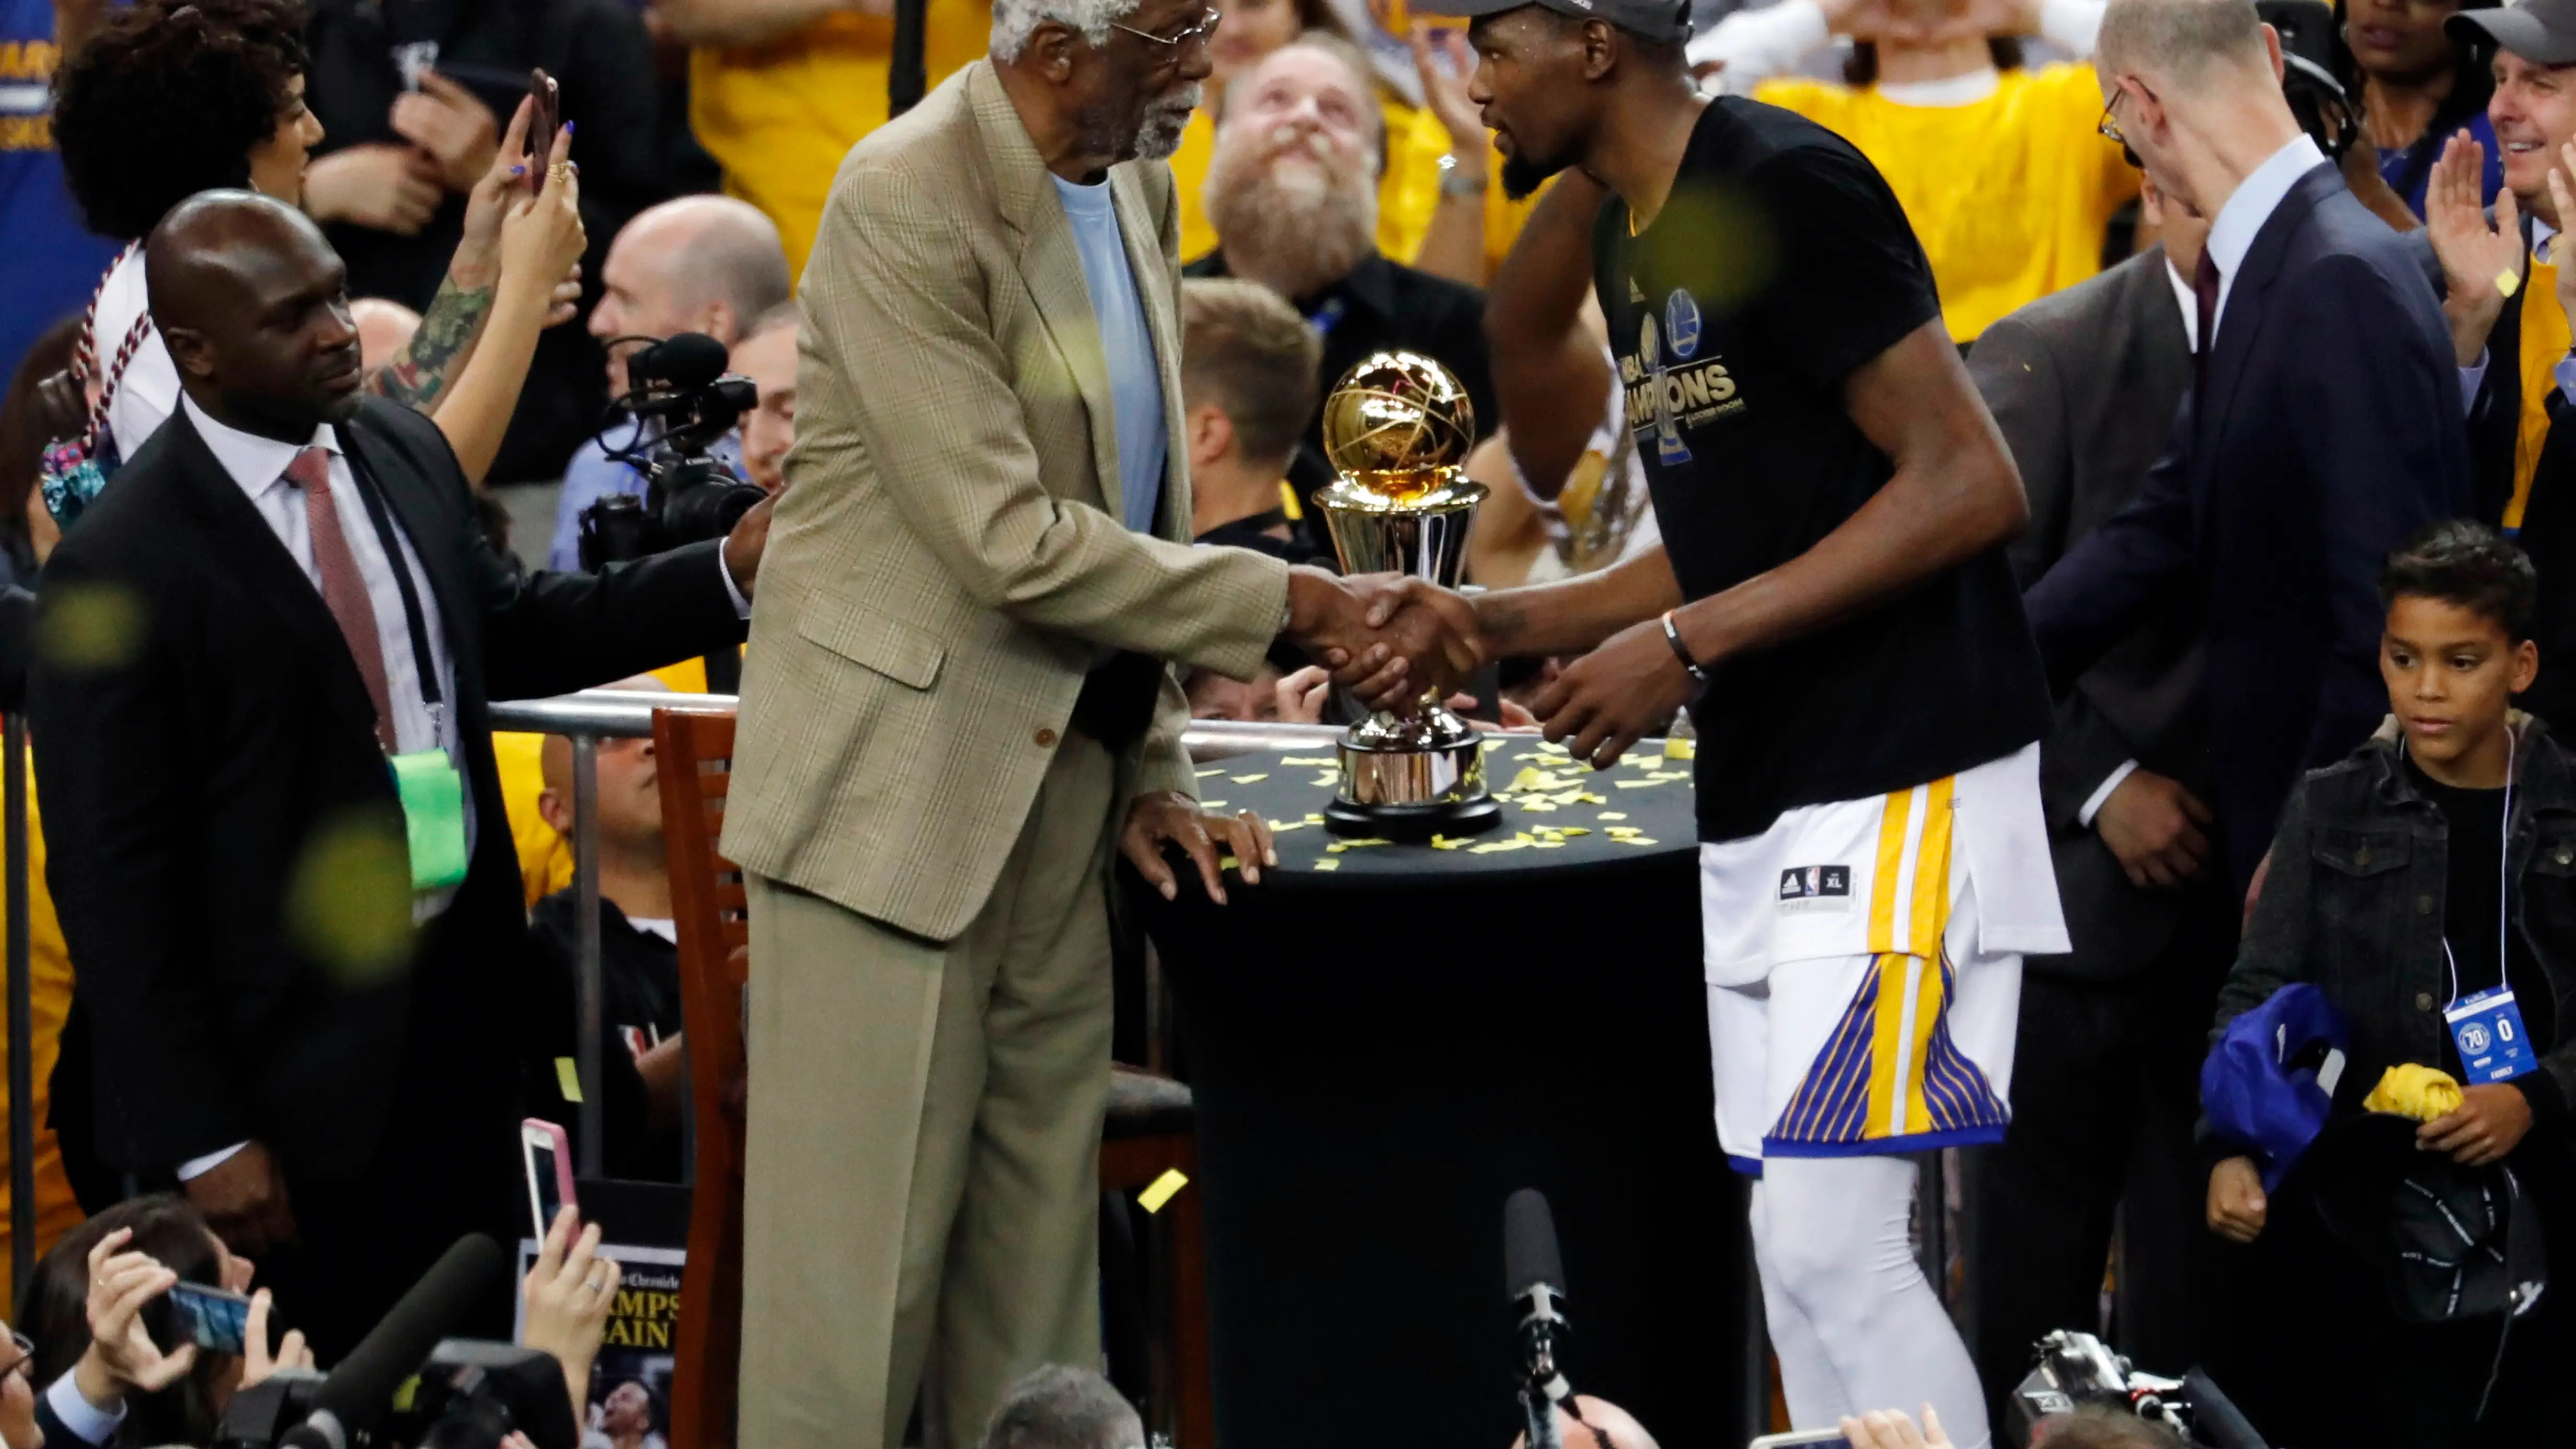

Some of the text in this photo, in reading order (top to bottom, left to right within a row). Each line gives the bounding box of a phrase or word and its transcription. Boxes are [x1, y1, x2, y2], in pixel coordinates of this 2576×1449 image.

[1826, 877, 1843, 888] XL
[2465, 1018, 2514, 1049] 70 0
[612, 1290, 680, 1319] MPS
